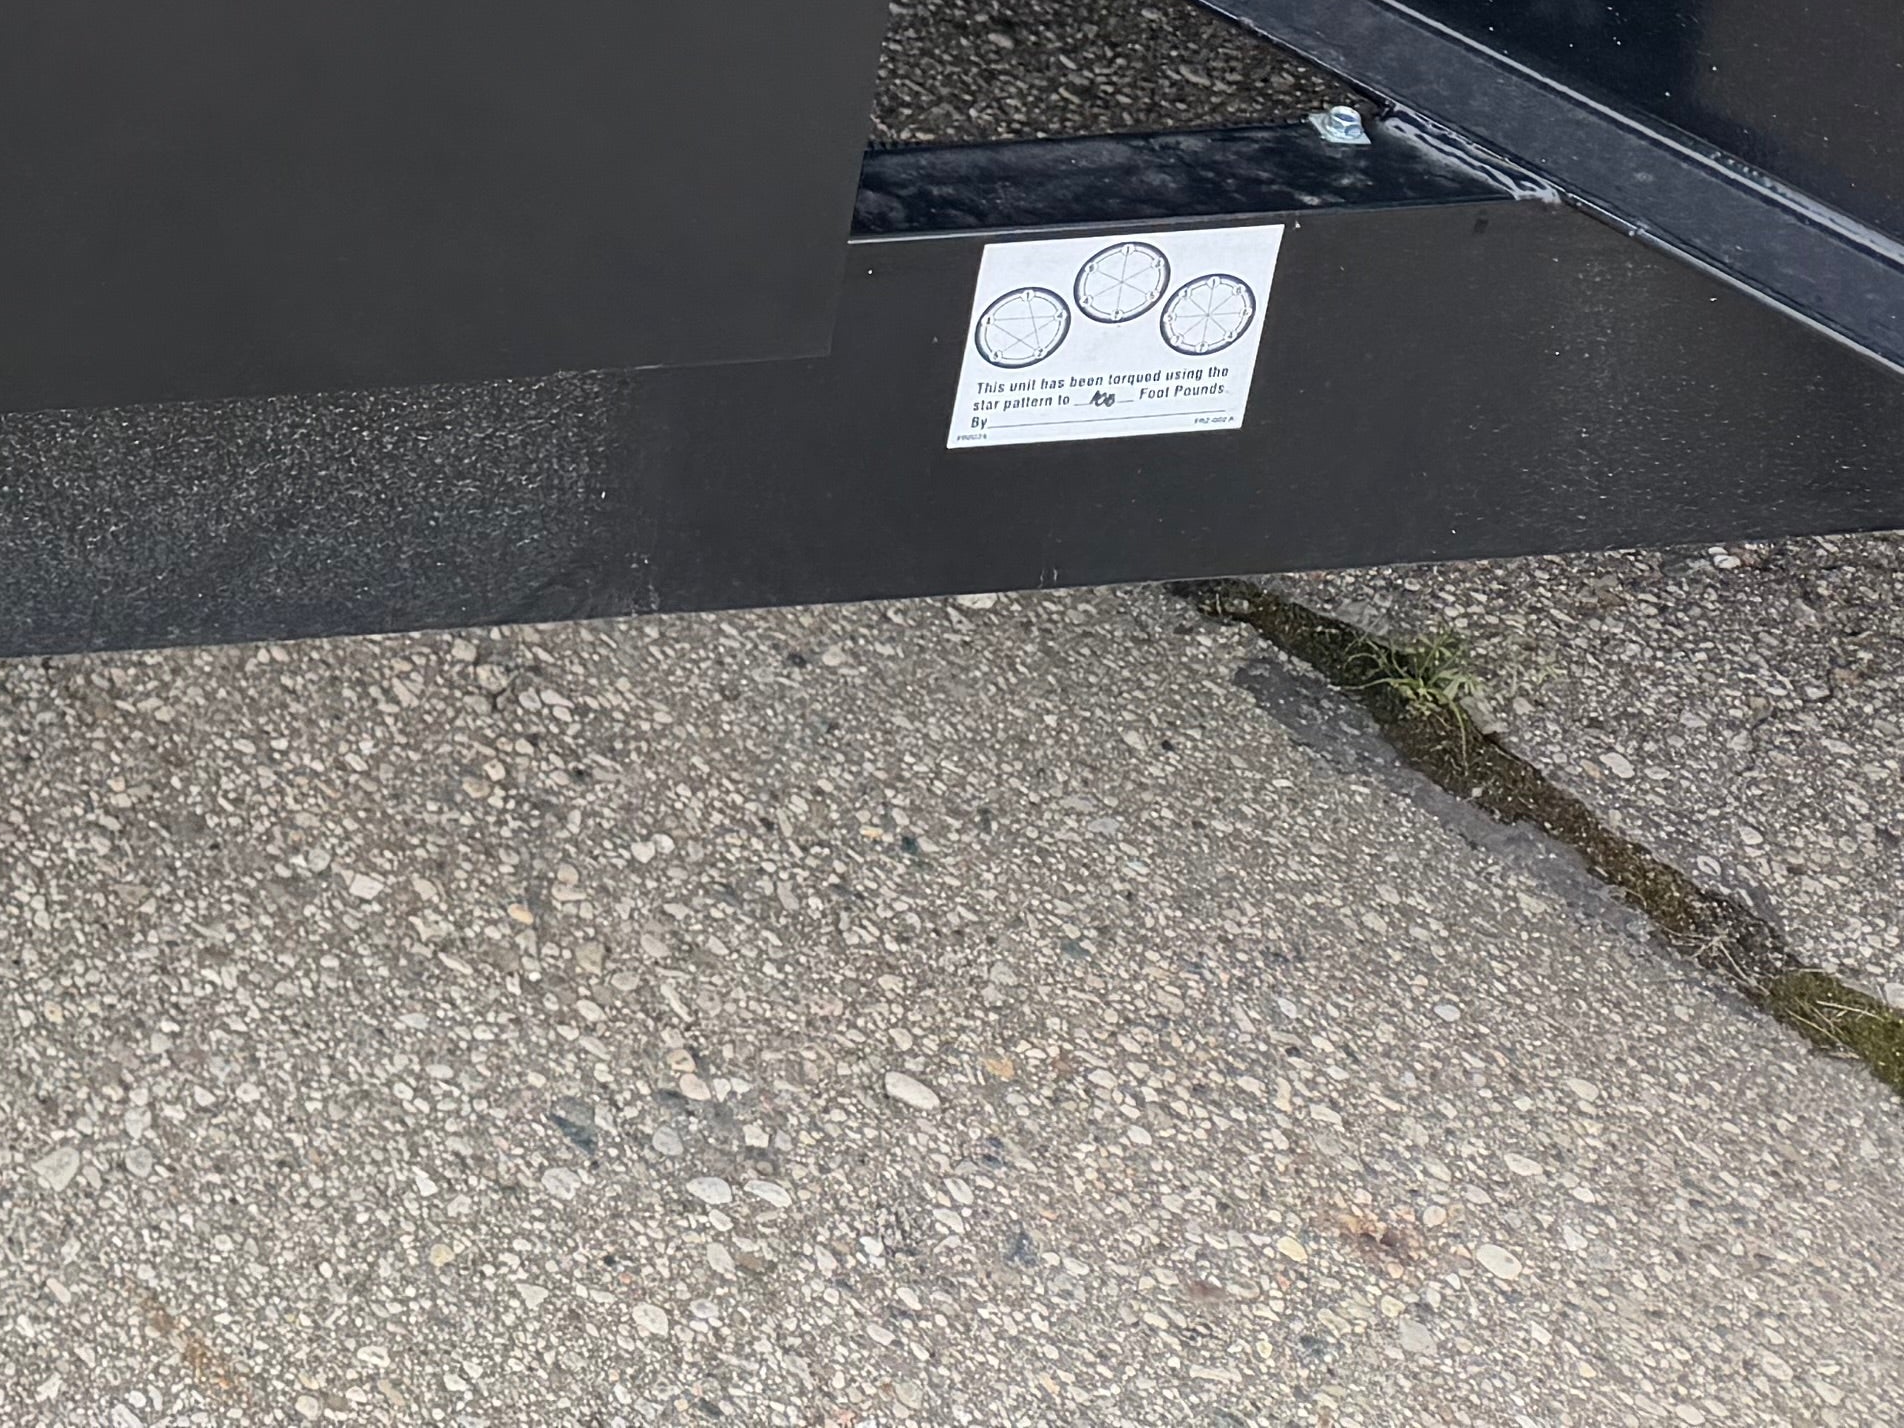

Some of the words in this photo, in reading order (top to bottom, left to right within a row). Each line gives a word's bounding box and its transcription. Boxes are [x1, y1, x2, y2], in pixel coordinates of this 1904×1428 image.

[977, 381, 1005, 394] This
[1010, 379, 1036, 392] unit
[1041, 378, 1065, 390] has
[1070, 376, 1103, 388] been
[1108, 370, 1161, 386] torqued
[1166, 368, 1203, 381] using
[1209, 366, 1229, 378] the
[973, 397, 999, 411] star
[1003, 396, 1053, 412] pattern
[1057, 395, 1070, 406] to
[1139, 387, 1169, 400] Foot
[971, 416, 987, 430] By
